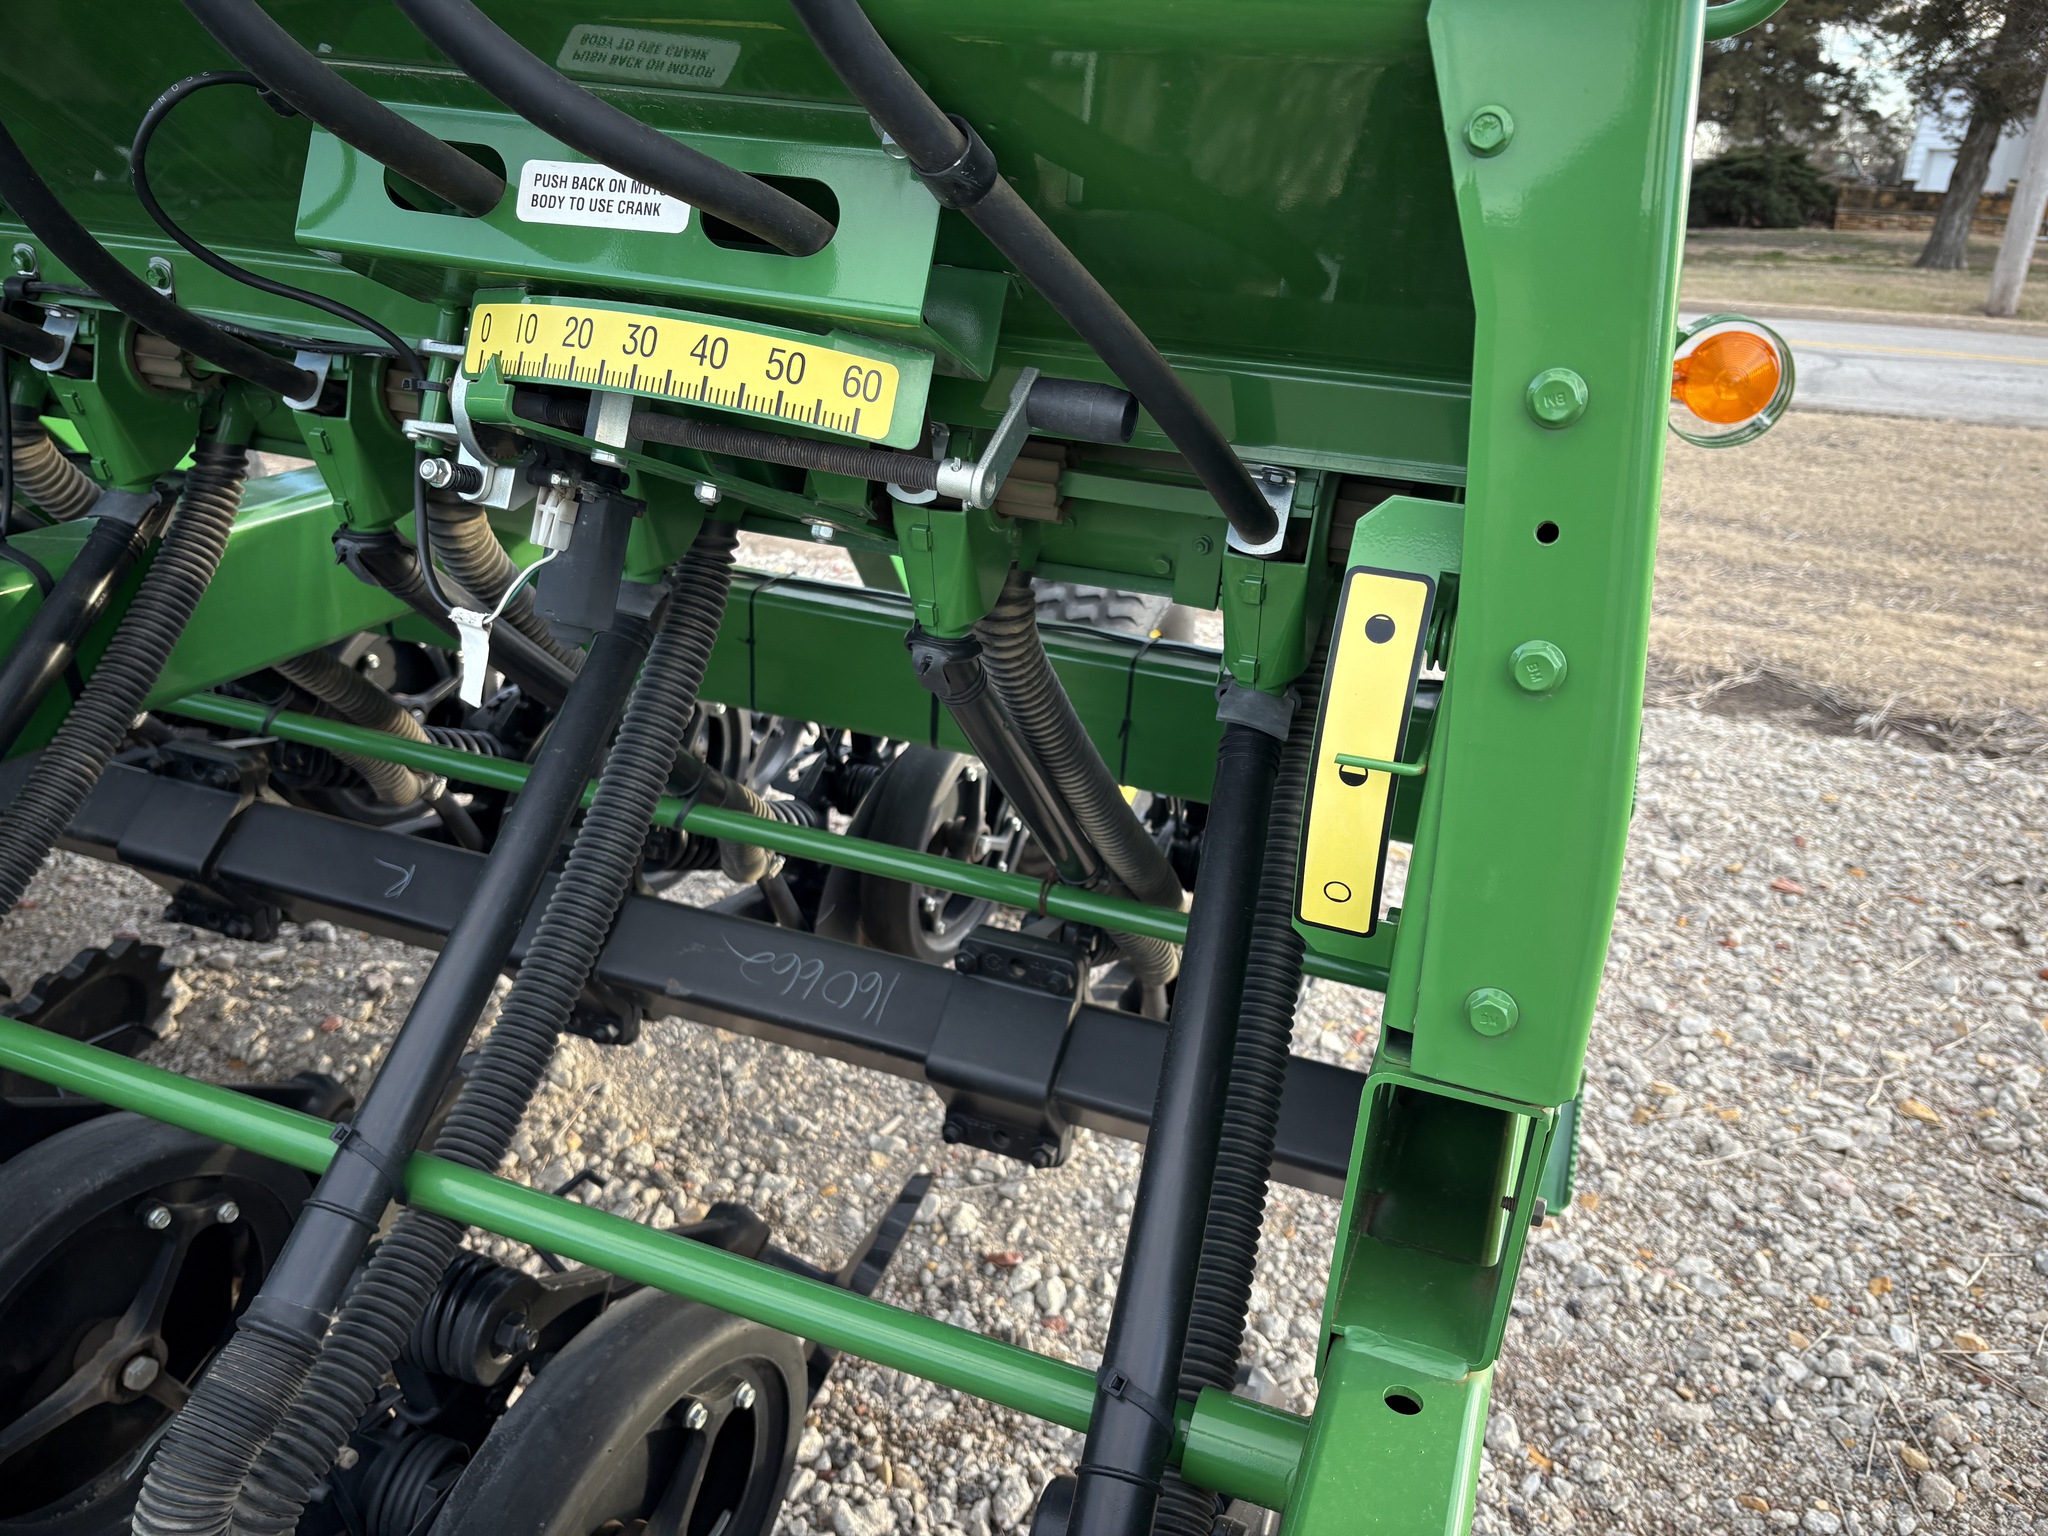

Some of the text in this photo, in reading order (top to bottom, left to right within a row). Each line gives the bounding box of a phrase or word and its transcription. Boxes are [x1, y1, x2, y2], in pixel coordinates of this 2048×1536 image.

[531, 194, 661, 216] BODY TO USE CRANK
[534, 173, 568, 189] PUSH
[572, 176, 605, 191] BACK
[608, 178, 627, 193] ON
[481, 313, 882, 403] 0 10 20 30 40 50 60
[721, 934, 901, 1027] 160662
